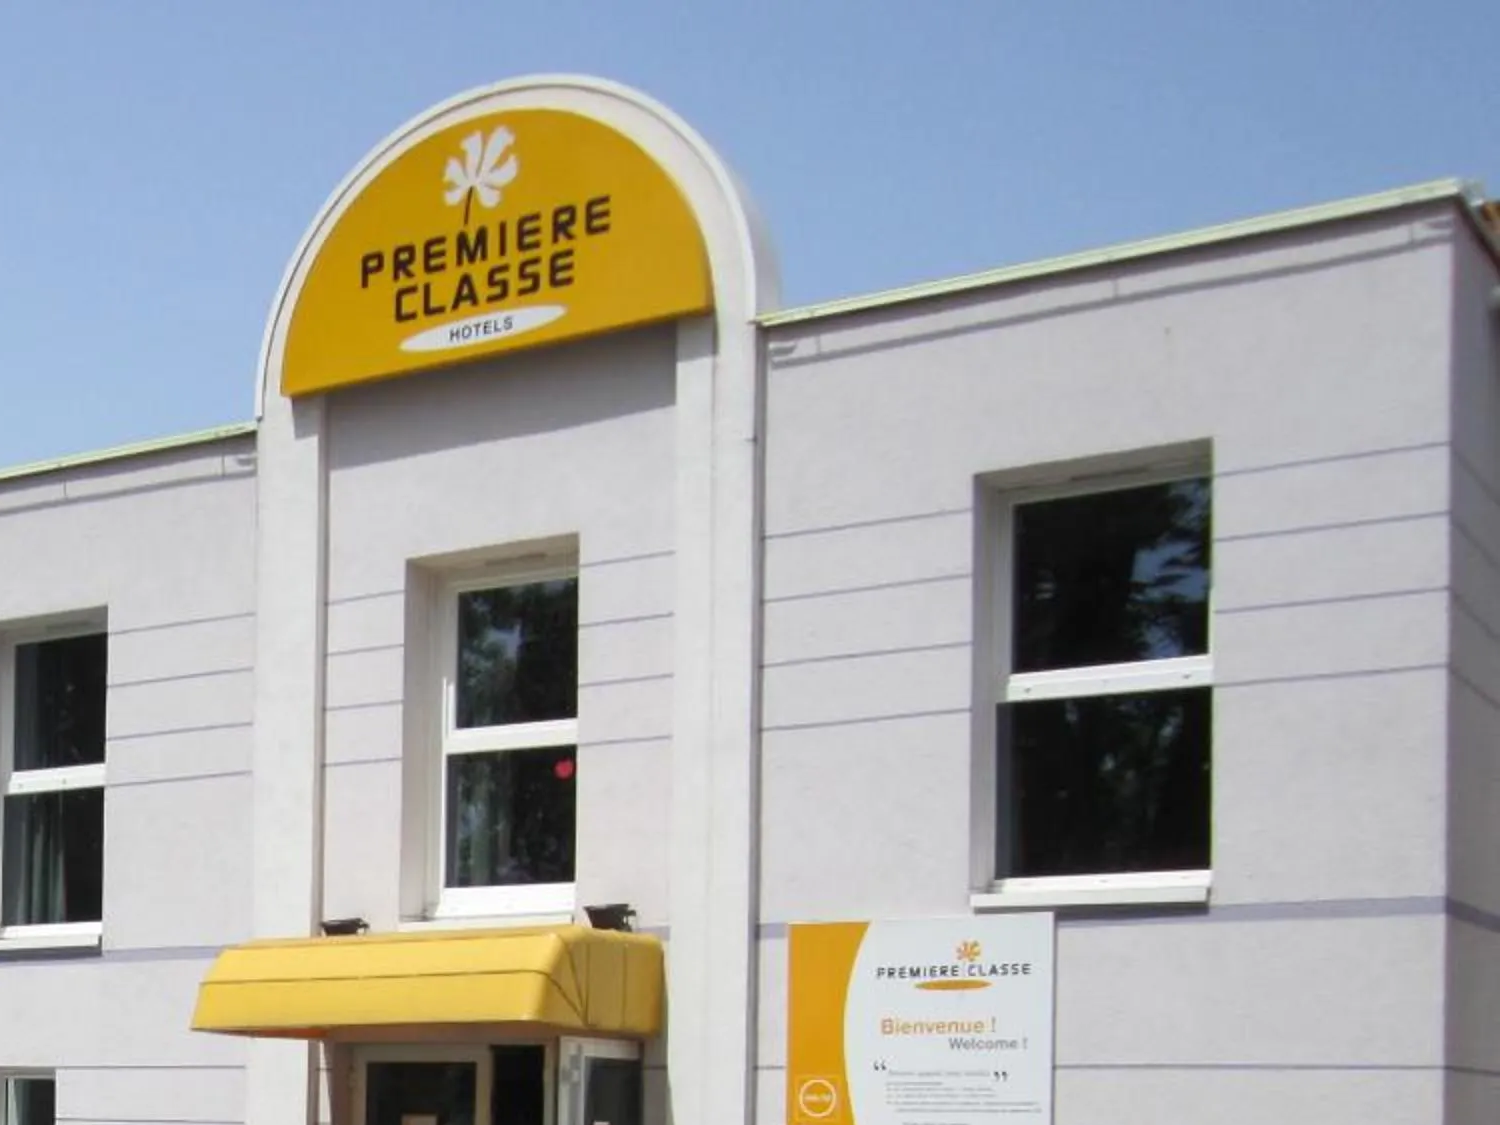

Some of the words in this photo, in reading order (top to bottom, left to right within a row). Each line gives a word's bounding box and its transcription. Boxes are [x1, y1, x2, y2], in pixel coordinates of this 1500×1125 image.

[361, 195, 612, 289] PREMIERE
[395, 249, 576, 323] CLASSE
[449, 316, 514, 342] HOTELS
[876, 964, 960, 979] PREMIERE
[967, 963, 1032, 977] CLASSE
[880, 1018, 985, 1035] Bienvenue
[948, 1037, 1018, 1051] Welcome
